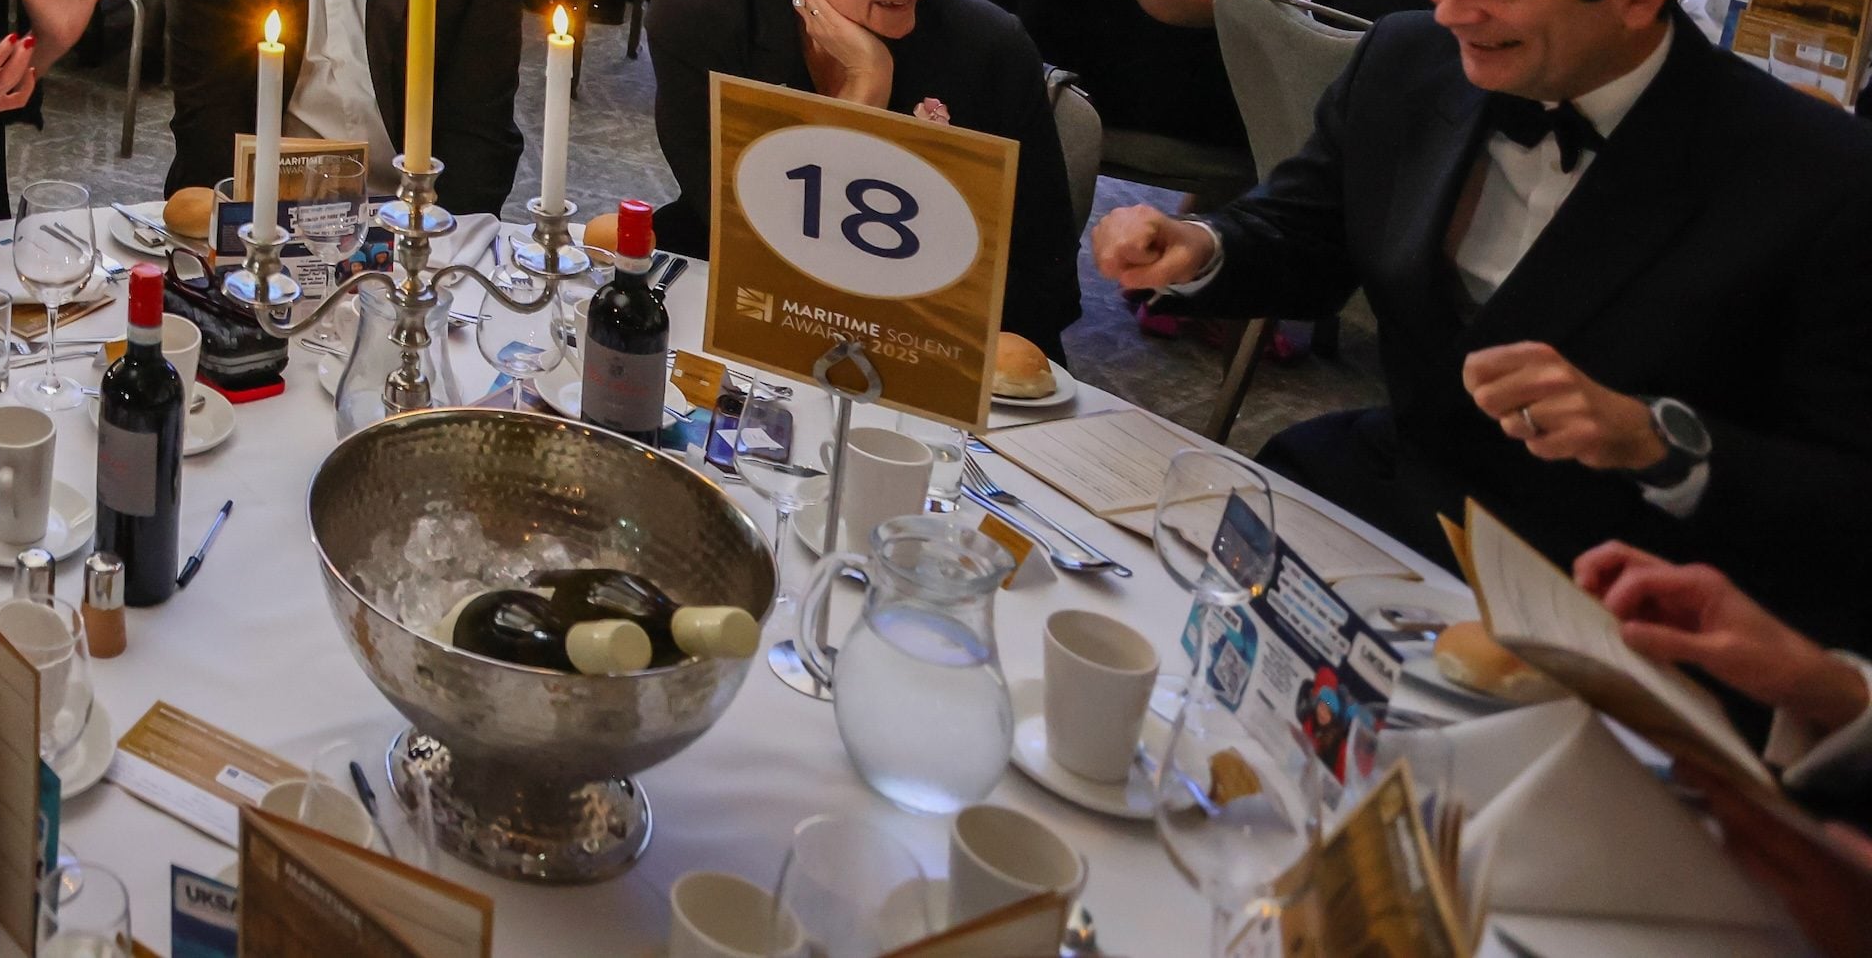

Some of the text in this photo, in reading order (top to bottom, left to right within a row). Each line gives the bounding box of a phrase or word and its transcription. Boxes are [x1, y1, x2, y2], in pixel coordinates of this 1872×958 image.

[785, 164, 920, 259] 18
[782, 299, 963, 359] MARITIME SOLENT
[872, 339, 919, 364] 2025
